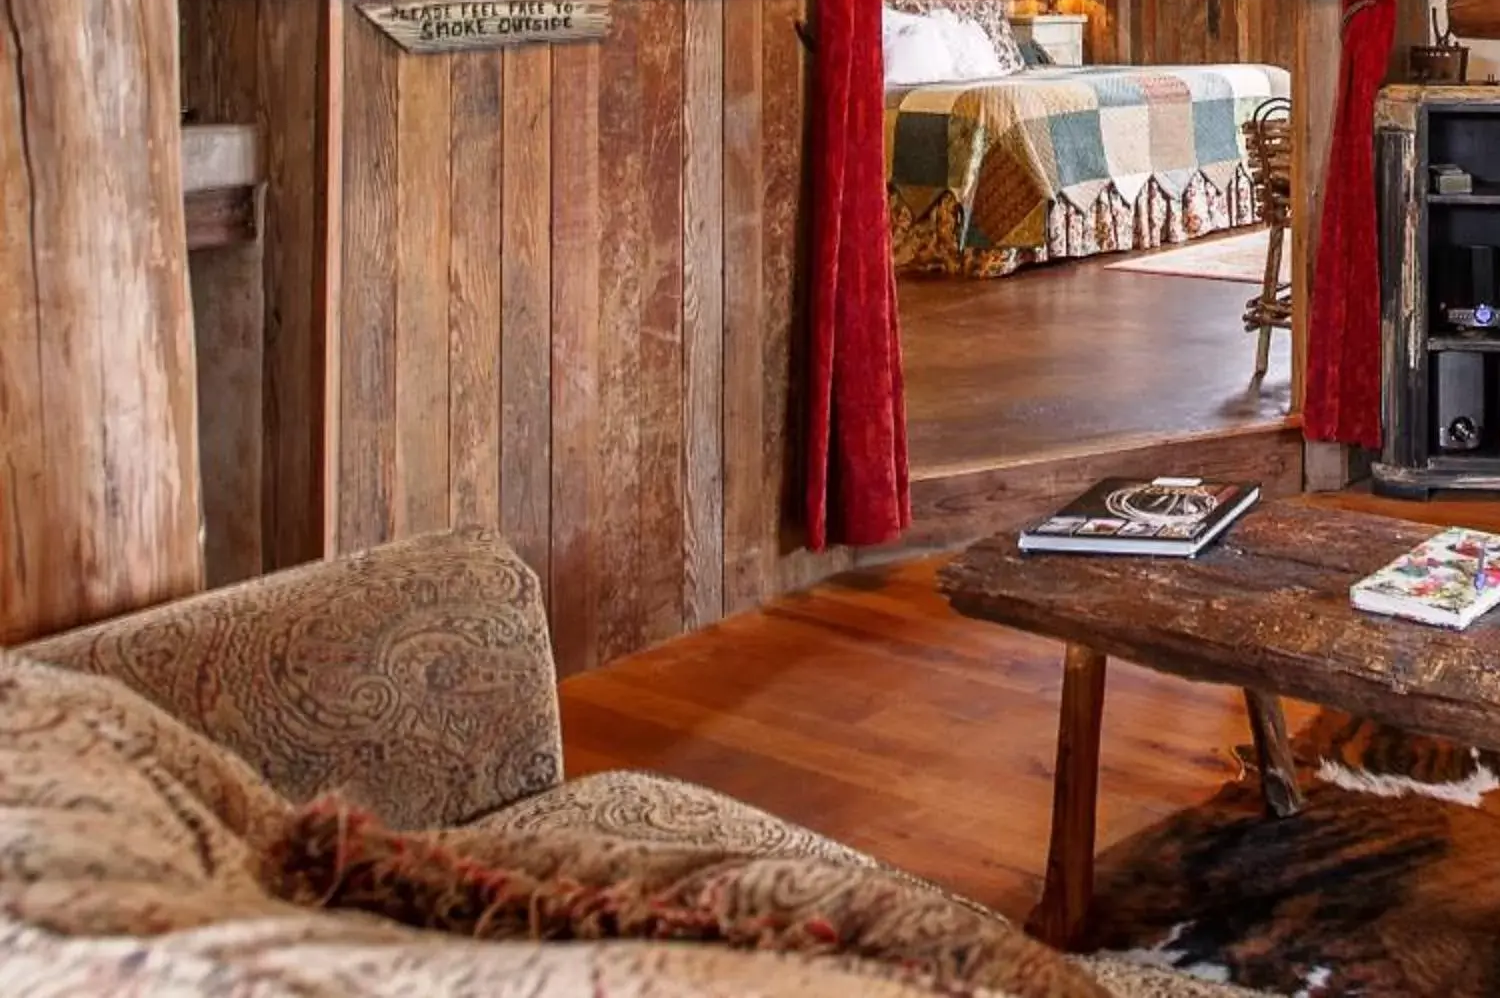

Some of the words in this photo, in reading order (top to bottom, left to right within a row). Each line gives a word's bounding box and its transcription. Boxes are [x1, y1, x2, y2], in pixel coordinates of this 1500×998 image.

[391, 4, 451, 22] PLEASE
[462, 1, 499, 18] FEEL
[509, 1, 545, 16] FREE
[556, 2, 574, 15] TO
[419, 17, 490, 40] SMOKE
[498, 16, 573, 34] OUTSIDE
